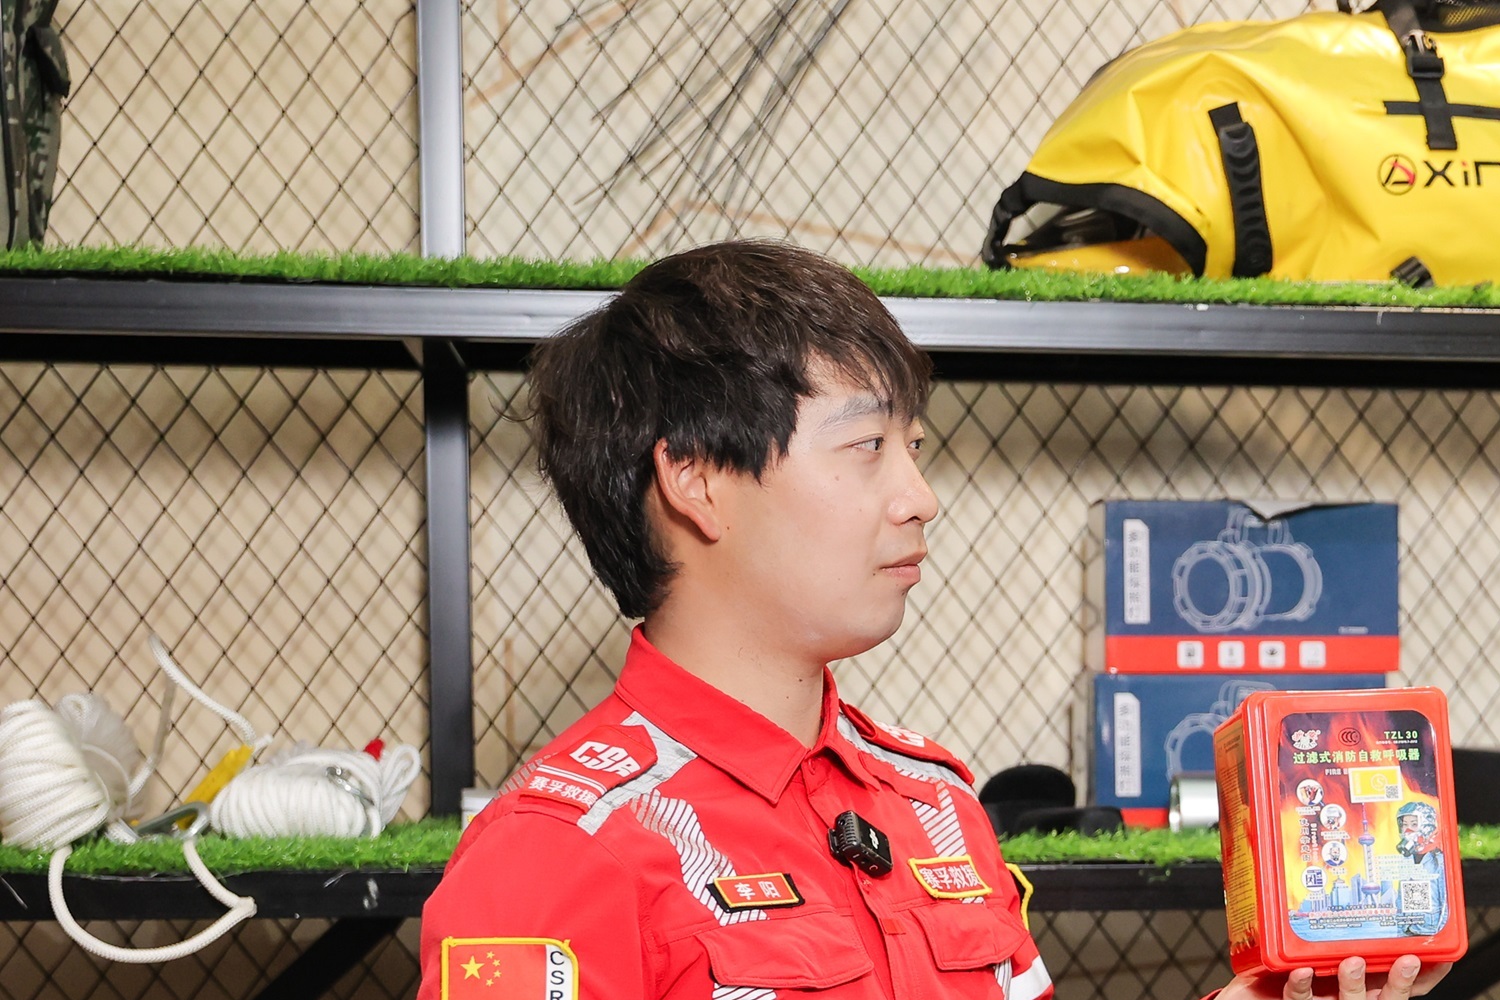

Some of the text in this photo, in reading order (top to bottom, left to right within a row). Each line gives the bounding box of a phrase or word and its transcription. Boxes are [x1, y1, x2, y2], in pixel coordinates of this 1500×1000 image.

[1384, 730, 1418, 740] TZL 30
[569, 741, 641, 777] CSR
[1293, 748, 1420, 764] 过滤式消防自救呼吸器
[528, 775, 599, 809] 赛孚救援
[919, 865, 981, 889] 赛孚救援
